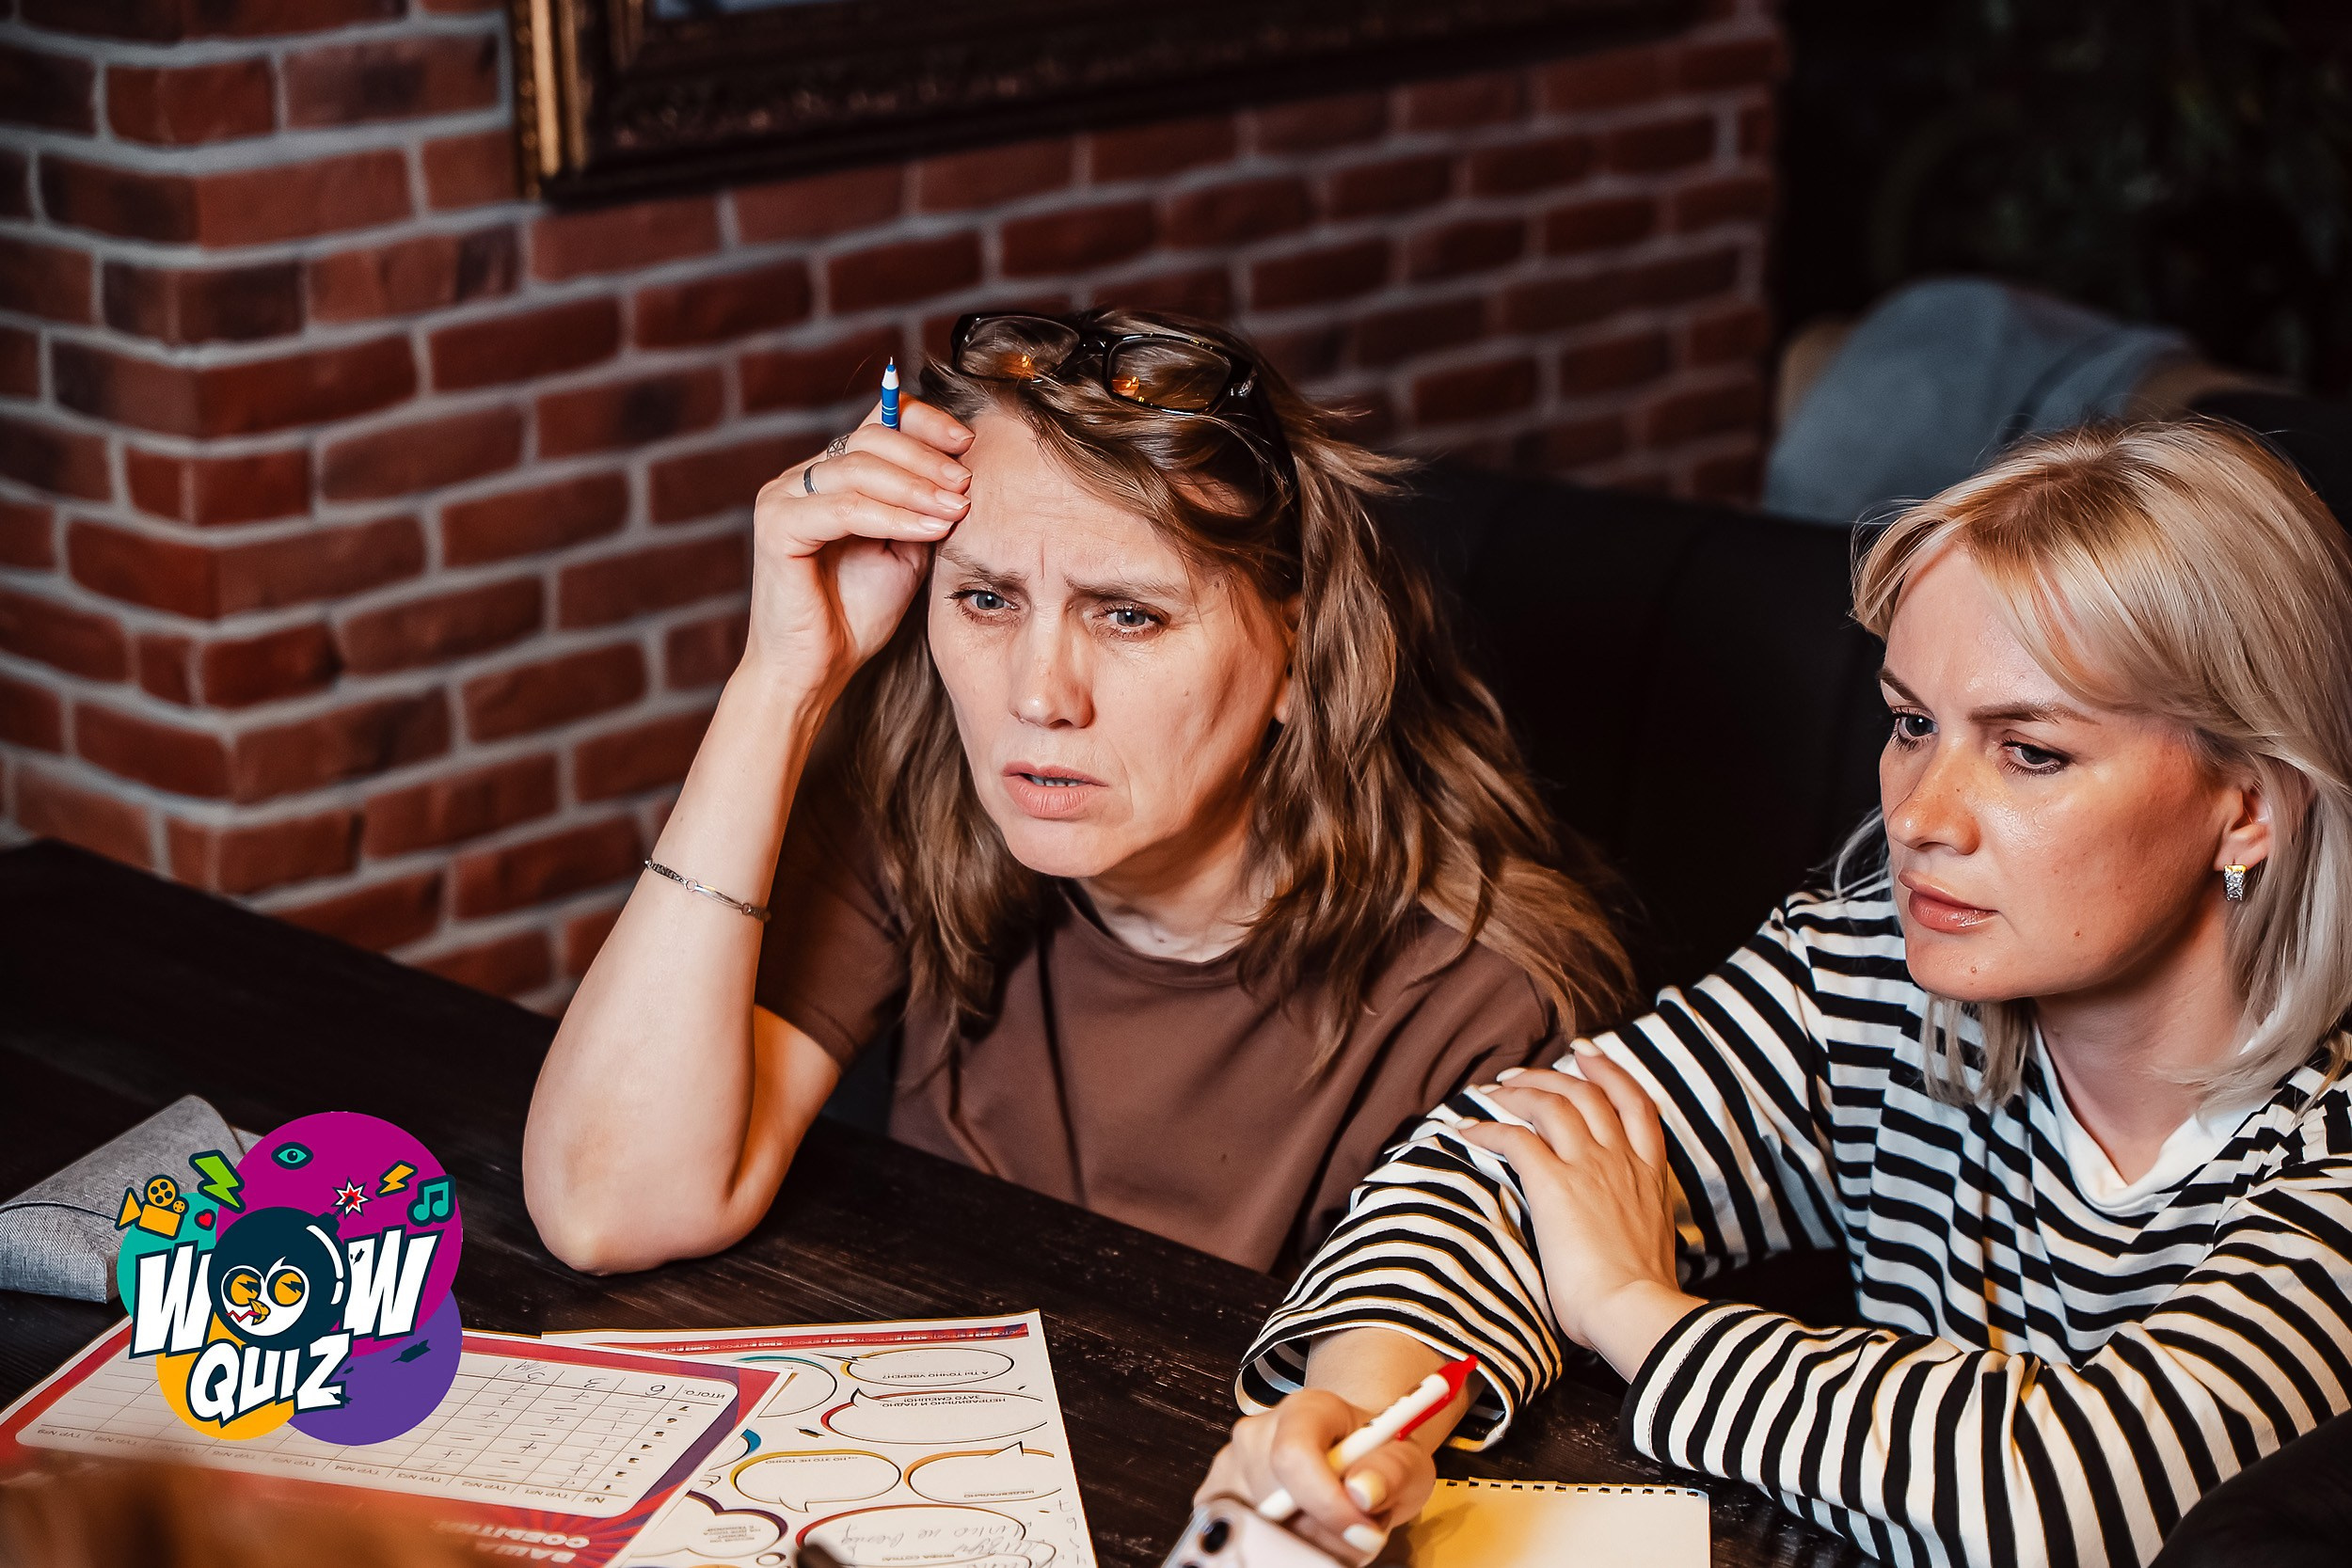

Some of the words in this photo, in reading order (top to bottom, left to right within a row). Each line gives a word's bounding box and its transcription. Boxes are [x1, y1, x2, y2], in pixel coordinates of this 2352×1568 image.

[644, 1384, 667, 1398] 6
[682, 1388, 726, 1401] ИТОГО:
[930, 1398, 1007, 1407] НЕПРАВИЛЬНО
[640, 1443, 653, 1451] 4
[963, 1490, 1035, 1499] ШЕДЕВРАЛЬНО
